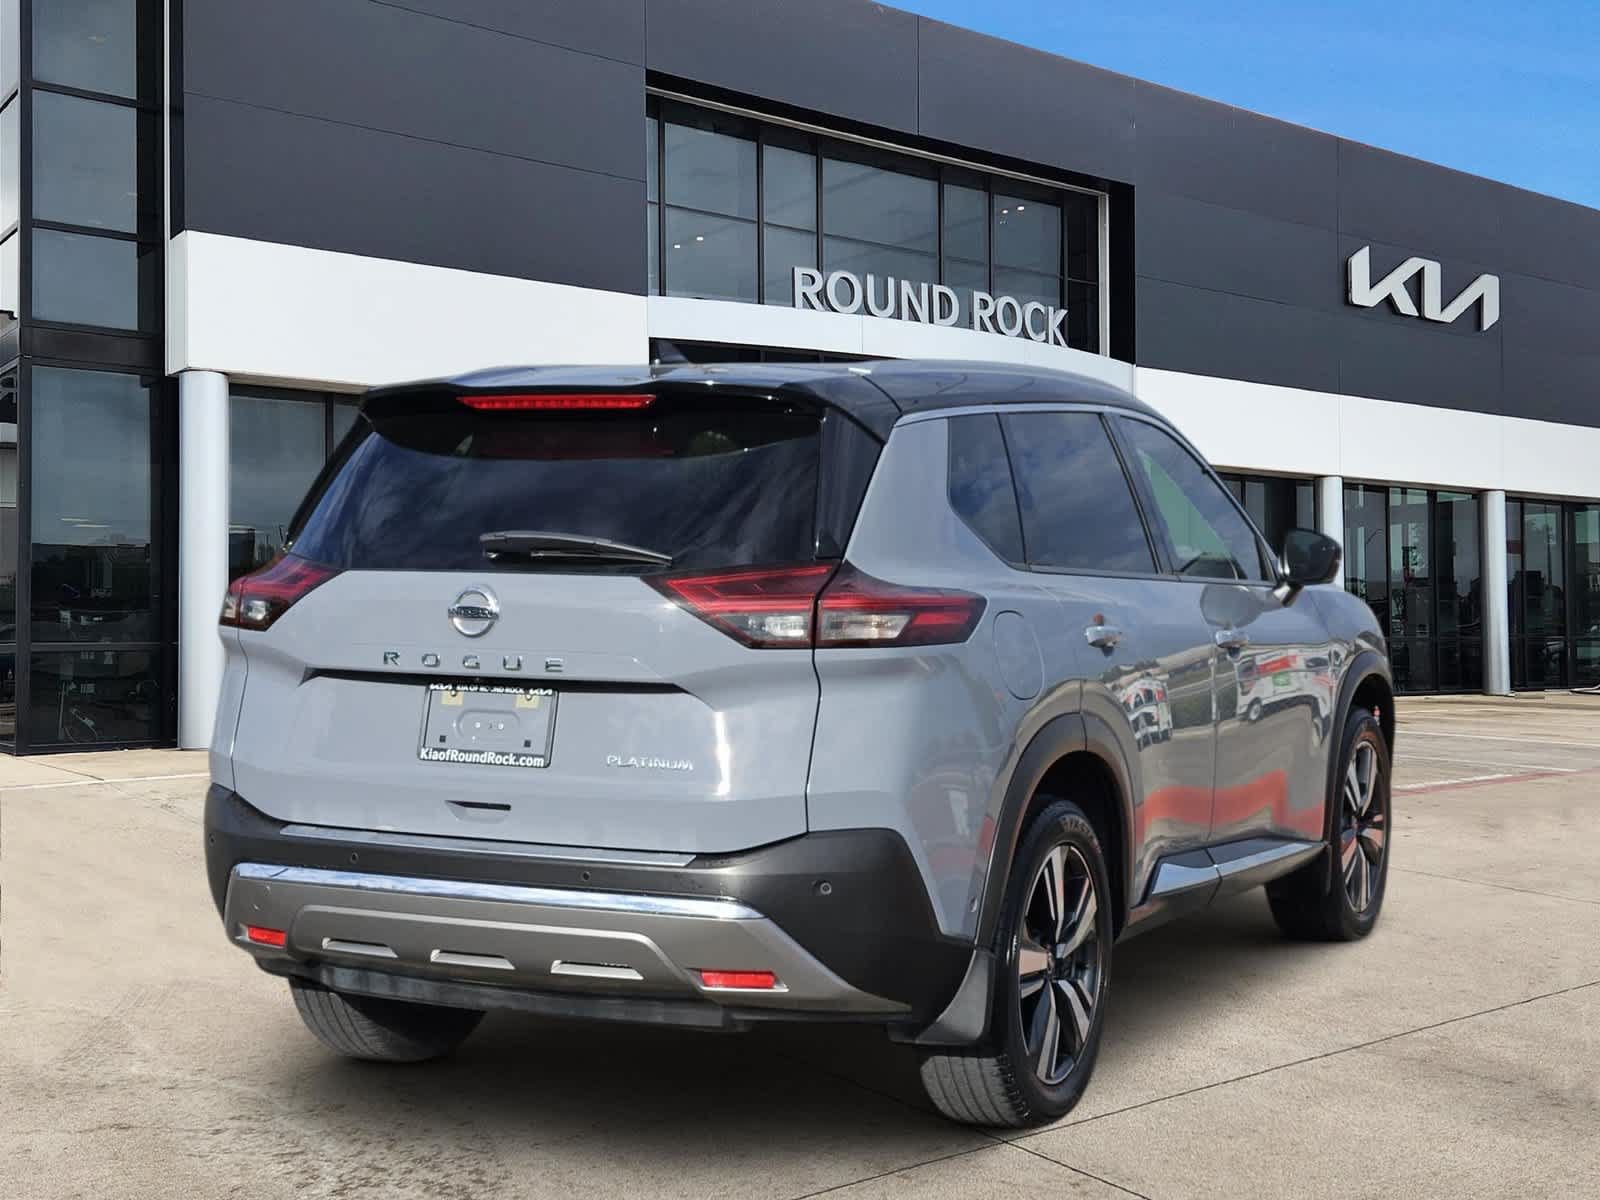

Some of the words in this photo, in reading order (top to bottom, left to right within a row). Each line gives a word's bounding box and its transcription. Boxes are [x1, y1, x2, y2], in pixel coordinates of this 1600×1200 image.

[1348, 245, 1500, 332] KIA
[792, 265, 960, 327] ROUND
[972, 289, 1069, 348] ROCK
[383, 651, 564, 673] ROGUE
[420, 748, 545, 767] KiaofRoundRock.com
[607, 754, 694, 771] PLATINUM
